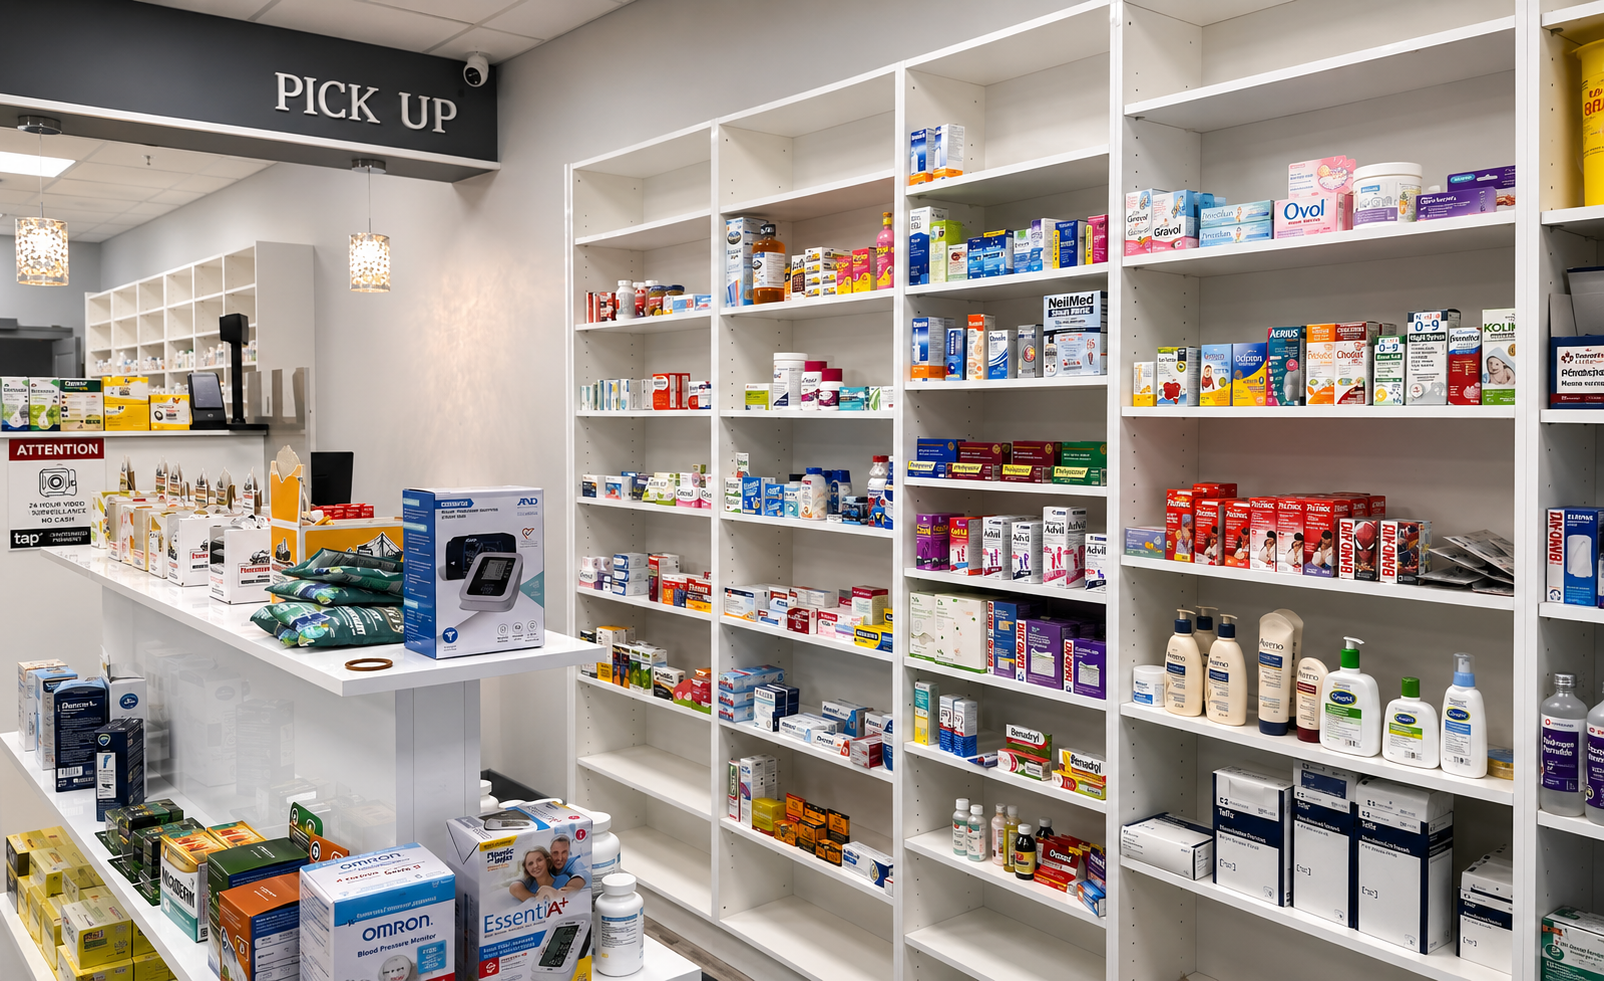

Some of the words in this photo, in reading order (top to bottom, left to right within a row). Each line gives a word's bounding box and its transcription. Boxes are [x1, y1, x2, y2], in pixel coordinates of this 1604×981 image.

[274, 71, 380, 124] PICK
[398, 90, 458, 134] UP
[1284, 198, 1325, 220] Ovol
[1154, 224, 1182, 237] Gravol
[1270, 329, 1298, 339] AERIUS
[16, 443, 98, 456] ATTENTION
[357, 947, 379, 958] Blood
